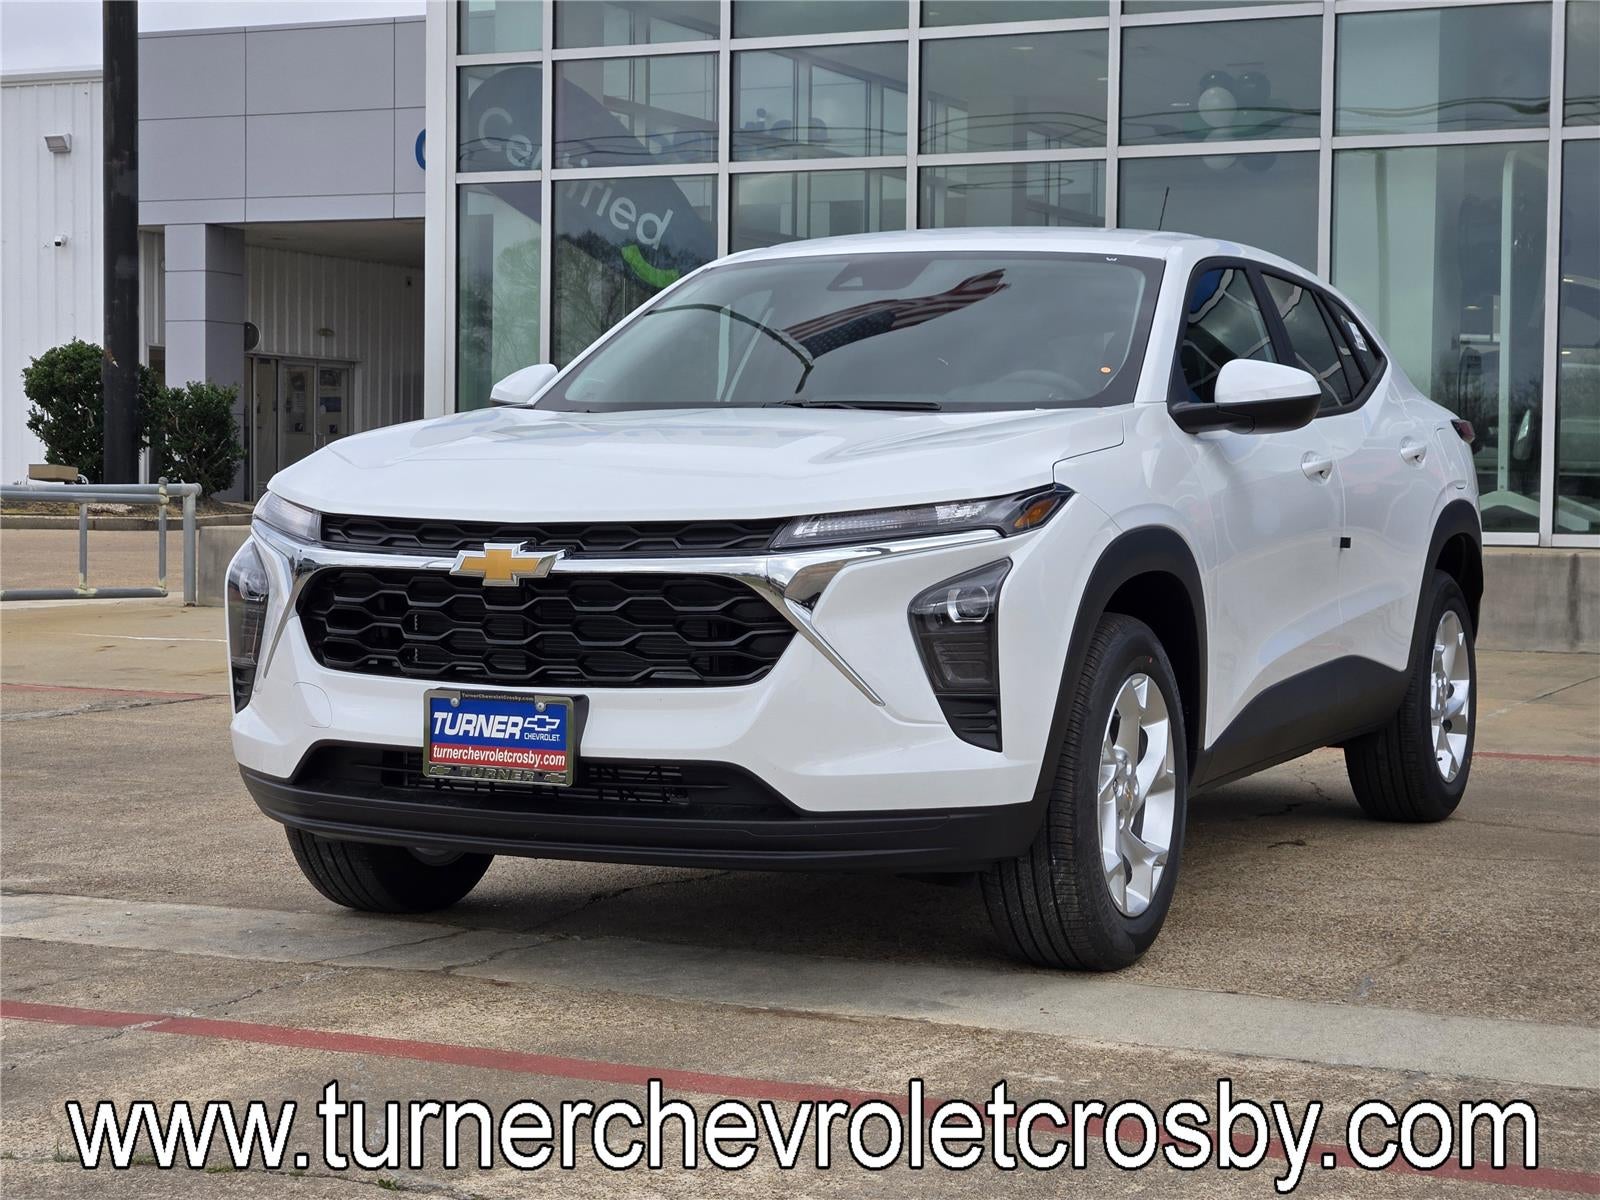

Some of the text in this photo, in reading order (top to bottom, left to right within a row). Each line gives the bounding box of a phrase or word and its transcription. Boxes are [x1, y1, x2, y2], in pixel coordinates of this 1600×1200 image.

[433, 711, 524, 739] TURNER
[524, 732, 560, 742] CHEVROLET
[433, 745, 565, 767] turnerchevroletcrosby.com
[460, 766, 535, 781] TURNER
